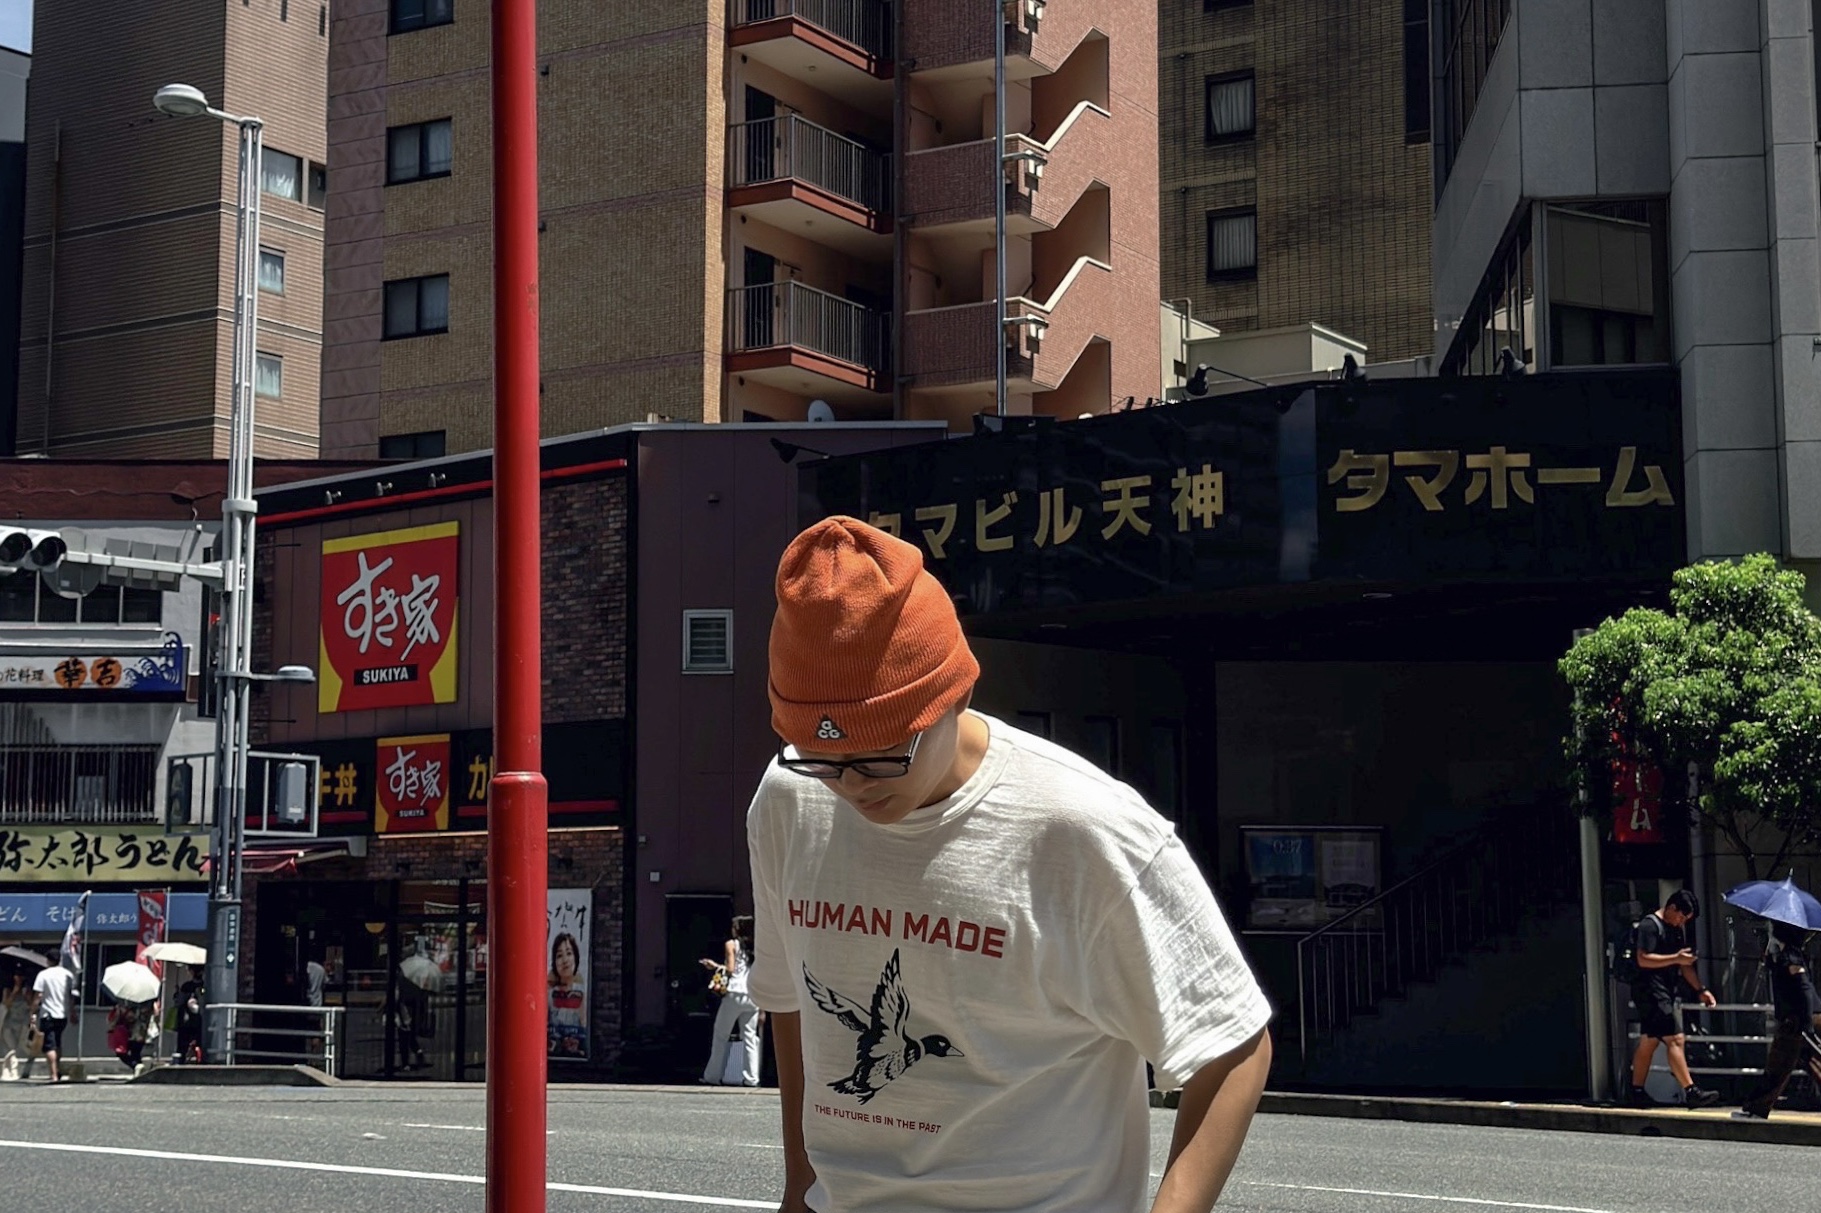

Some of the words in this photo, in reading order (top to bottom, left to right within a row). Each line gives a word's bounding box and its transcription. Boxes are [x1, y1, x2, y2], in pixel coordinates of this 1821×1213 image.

[1327, 446, 1675, 512] タマホーム
[336, 551, 440, 662] すき家
[362, 667, 409, 684] SUKIYA
[385, 746, 442, 807] すき家
[788, 899, 892, 938] HUMAN
[903, 911, 1007, 959] MADE
[814, 1104, 831, 1116] THE
[833, 1108, 870, 1123] FUTURE
[872, 1114, 882, 1124] IS
[884, 1116, 894, 1126] IN
[896, 1118, 916, 1130] THE
[918, 1122, 942, 1134] PAST
